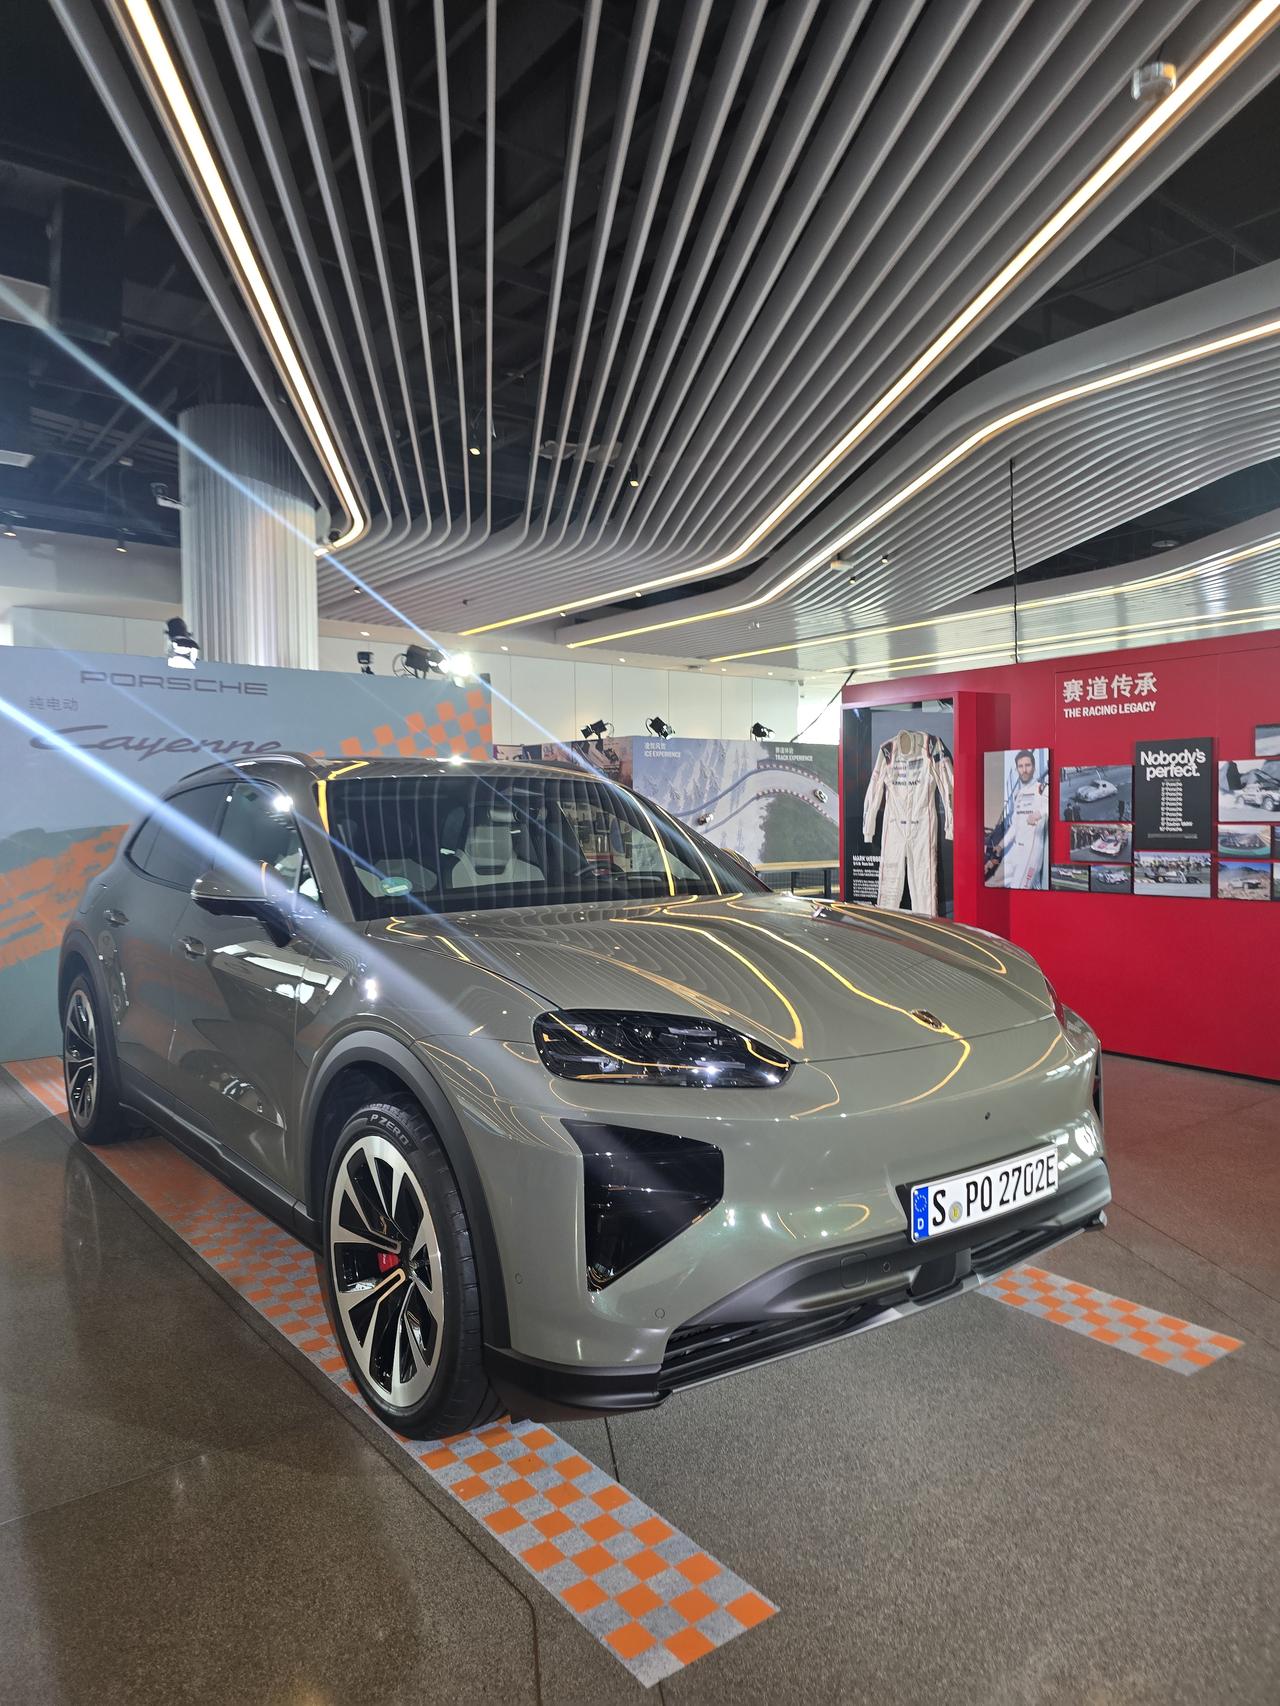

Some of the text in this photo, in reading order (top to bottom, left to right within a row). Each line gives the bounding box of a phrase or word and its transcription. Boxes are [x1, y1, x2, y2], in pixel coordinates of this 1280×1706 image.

[80, 670, 269, 696] PORSCHE
[1062, 672, 1158, 703] 赛道传承
[1063, 701, 1157, 718] THE RACING LEGACY
[30, 724, 282, 762] Cayenne
[1140, 748, 1206, 766] Nobody's
[1146, 763, 1200, 781] perfect.
[379, 1117, 410, 1145] ZERO
[932, 1154, 1056, 1227] S PO 2702E
[917, 1218, 925, 1230] D
